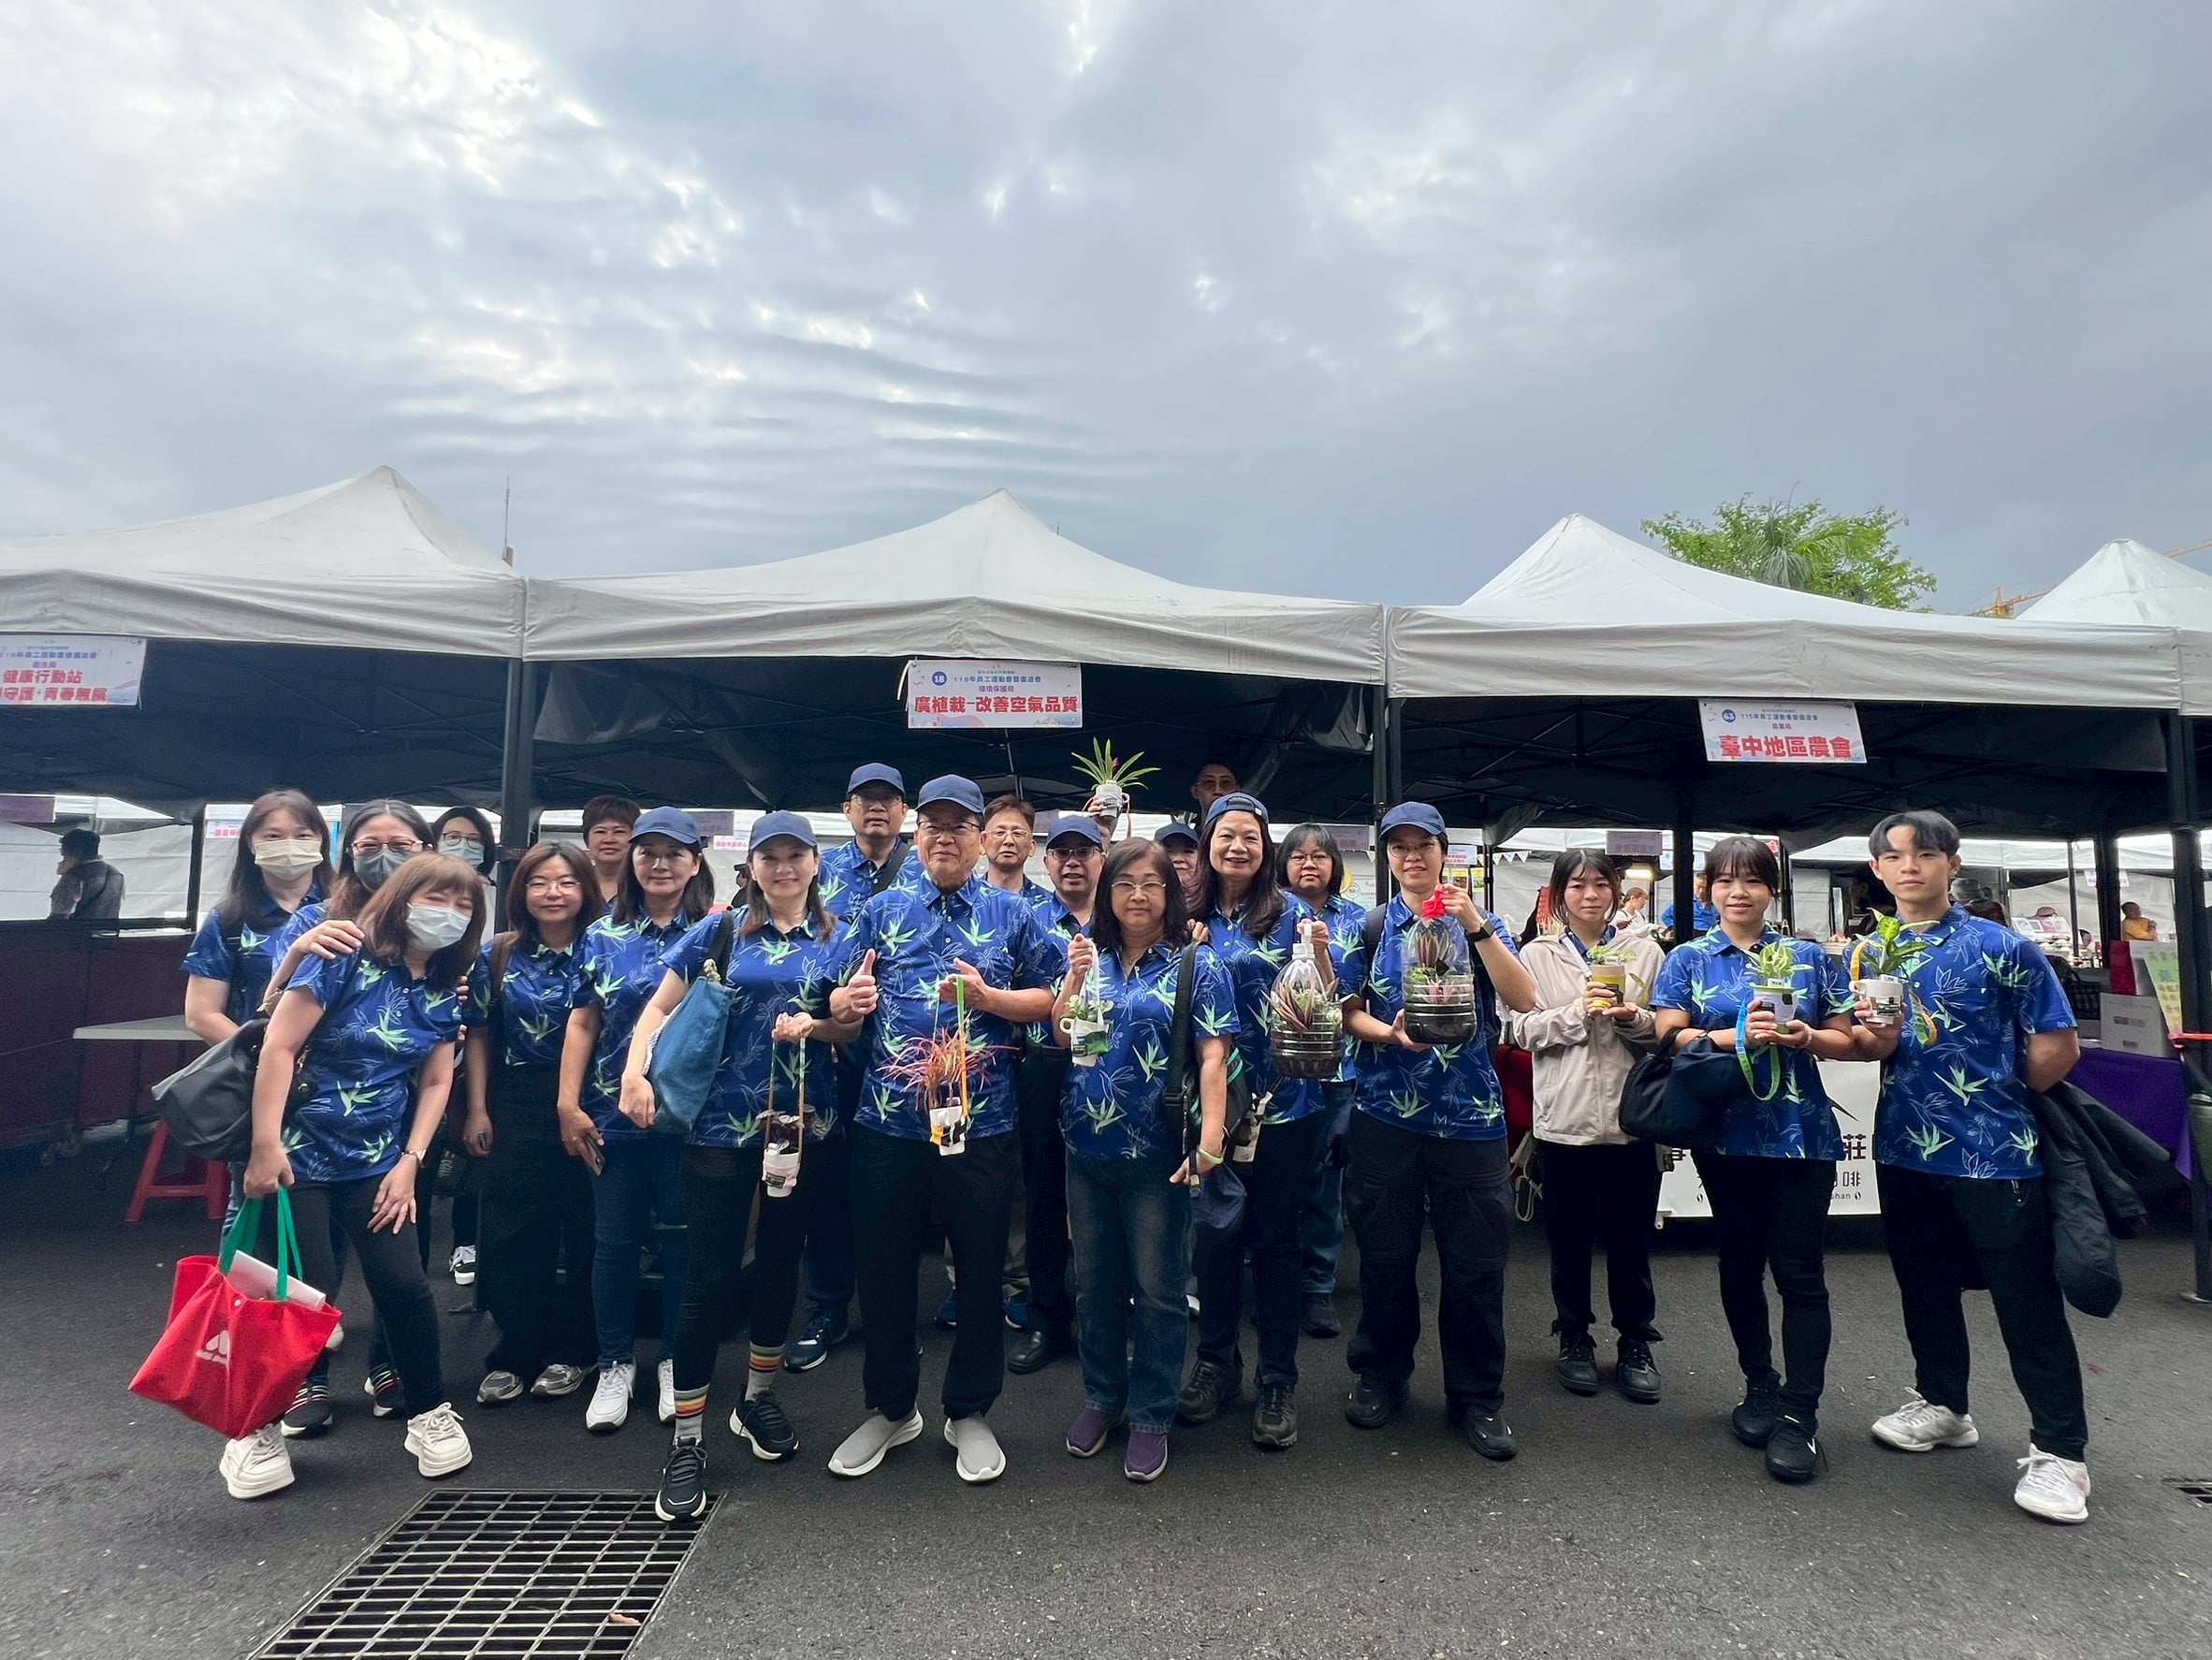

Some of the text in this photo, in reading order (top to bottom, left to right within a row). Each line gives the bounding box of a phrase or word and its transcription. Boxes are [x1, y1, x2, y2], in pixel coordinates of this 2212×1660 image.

[3, 669, 83, 684] 健康行動站
[934, 675, 945, 684] 18
[1719, 735, 1851, 759] 臺中地區農會
